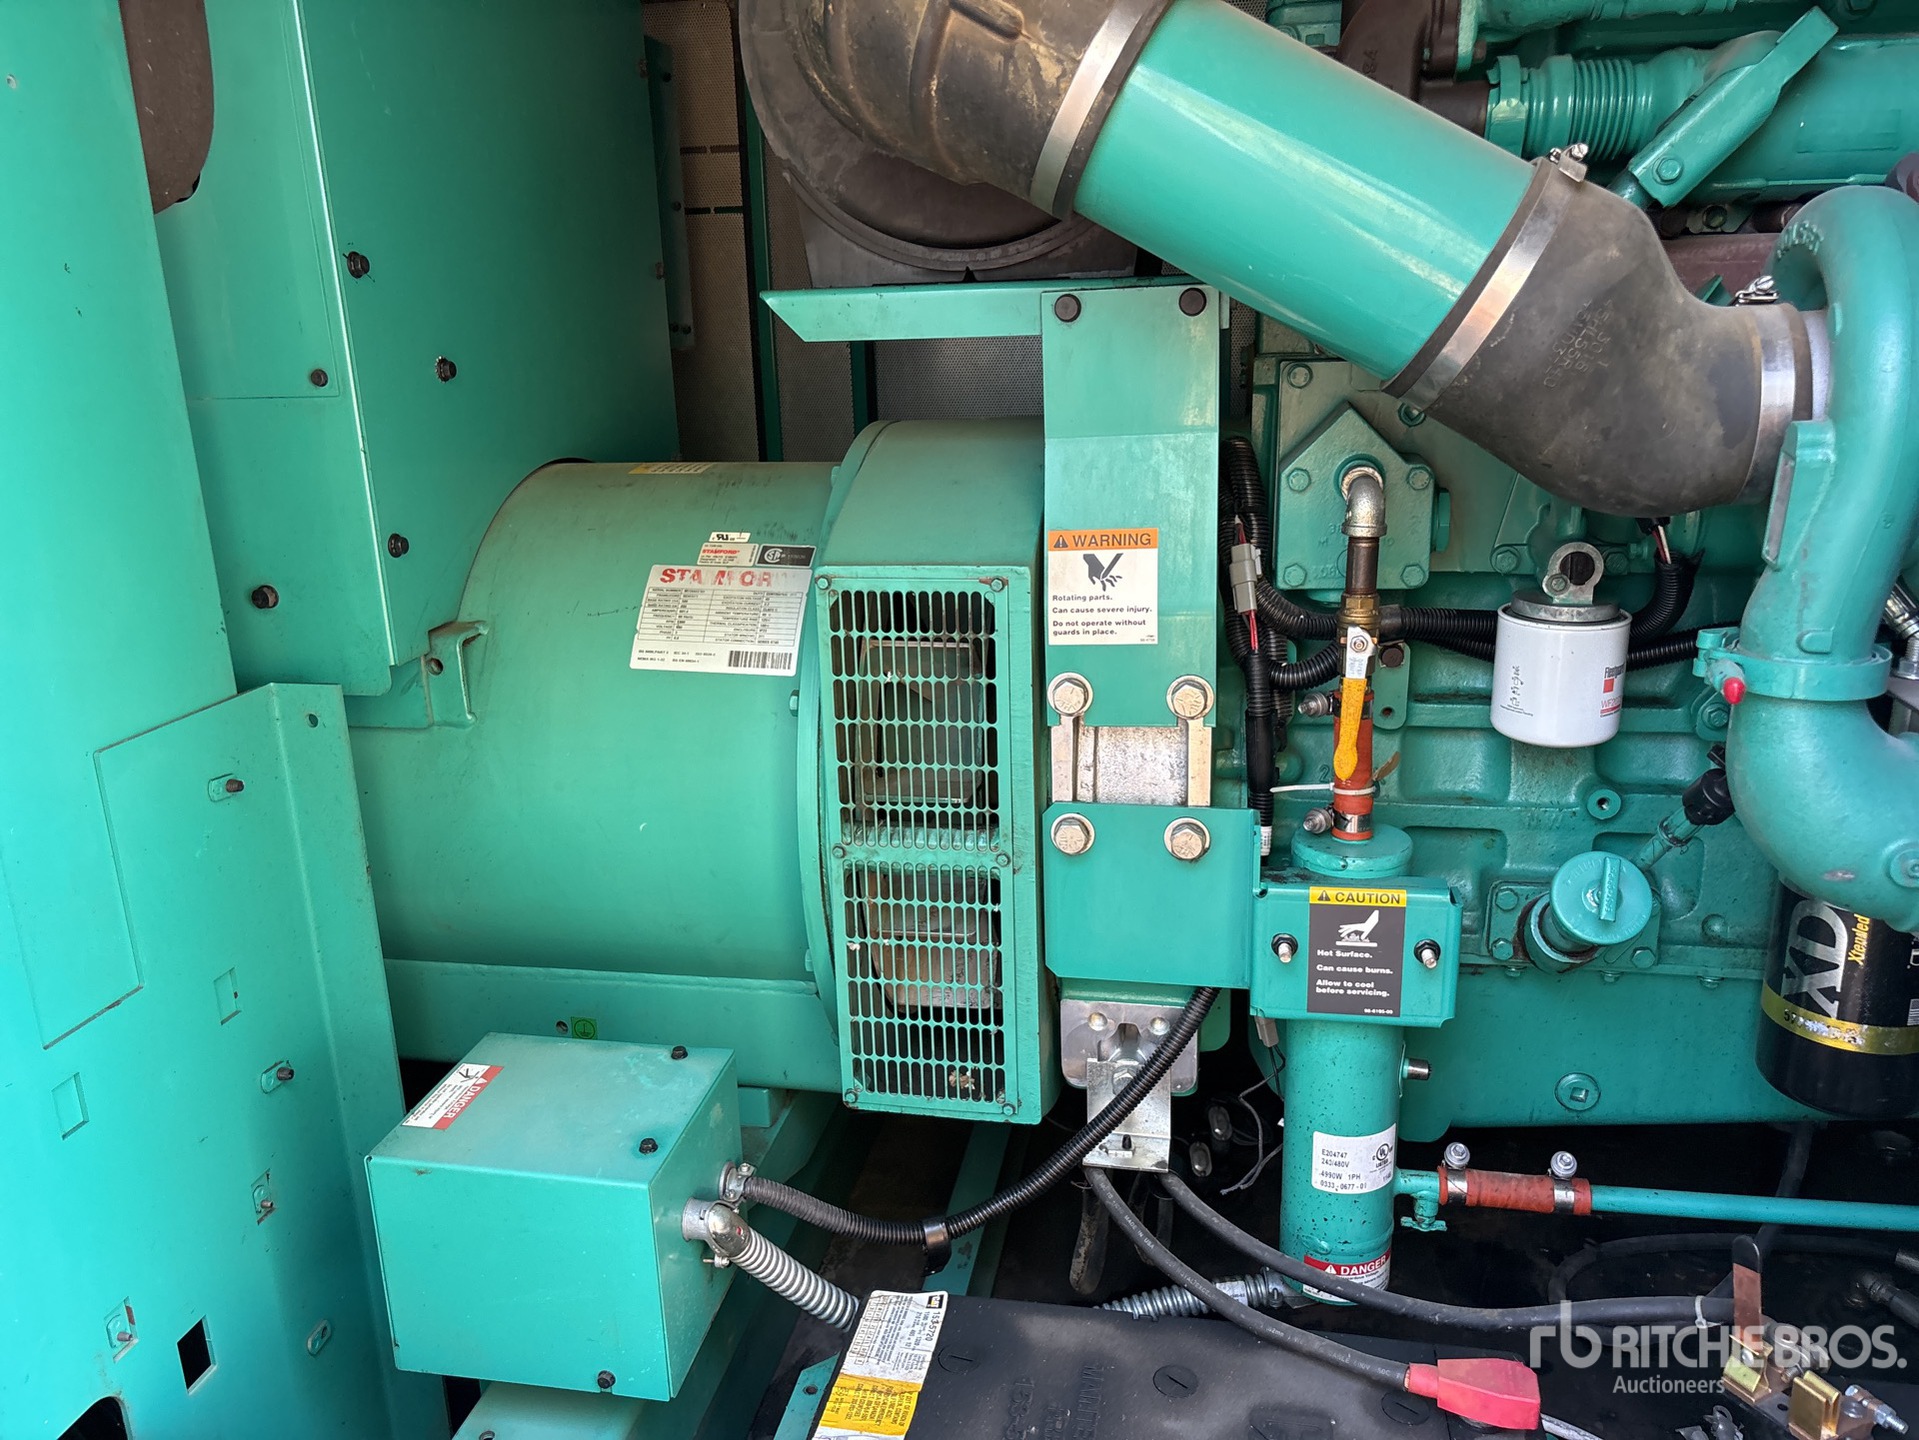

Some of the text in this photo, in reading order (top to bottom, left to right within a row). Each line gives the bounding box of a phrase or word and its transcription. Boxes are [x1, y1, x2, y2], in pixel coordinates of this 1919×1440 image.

[1072, 533, 1151, 547] WARNING
[1335, 892, 1400, 904] CAUTION
[1336, 950, 1373, 958] Surface.
[1347, 989, 1390, 997] servicing.
[444, 1086, 481, 1118] DANGER
[1124, 1214, 1137, 1230] MADE
[1144, 1238, 1155, 1249] USA
[1340, 1255, 1386, 1275] DANGER
[928, 1296, 941, 1307] CAT
